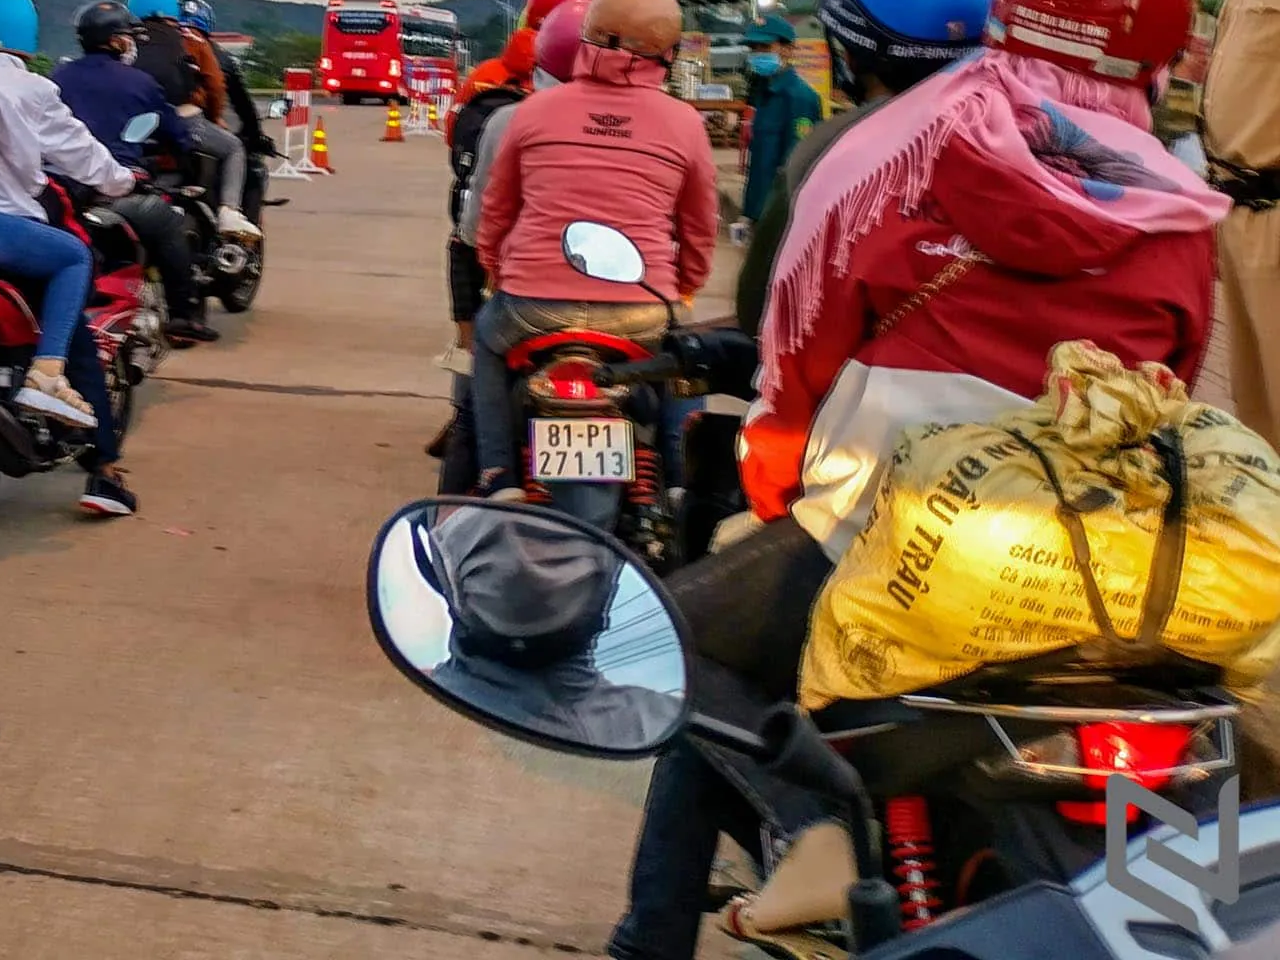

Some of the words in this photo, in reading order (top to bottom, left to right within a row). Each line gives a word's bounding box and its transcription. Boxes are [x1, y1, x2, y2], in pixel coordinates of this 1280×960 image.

[548, 423, 612, 448] 81-P1
[538, 450, 625, 477] 271.13
[886, 525, 945, 611] TRÂU
